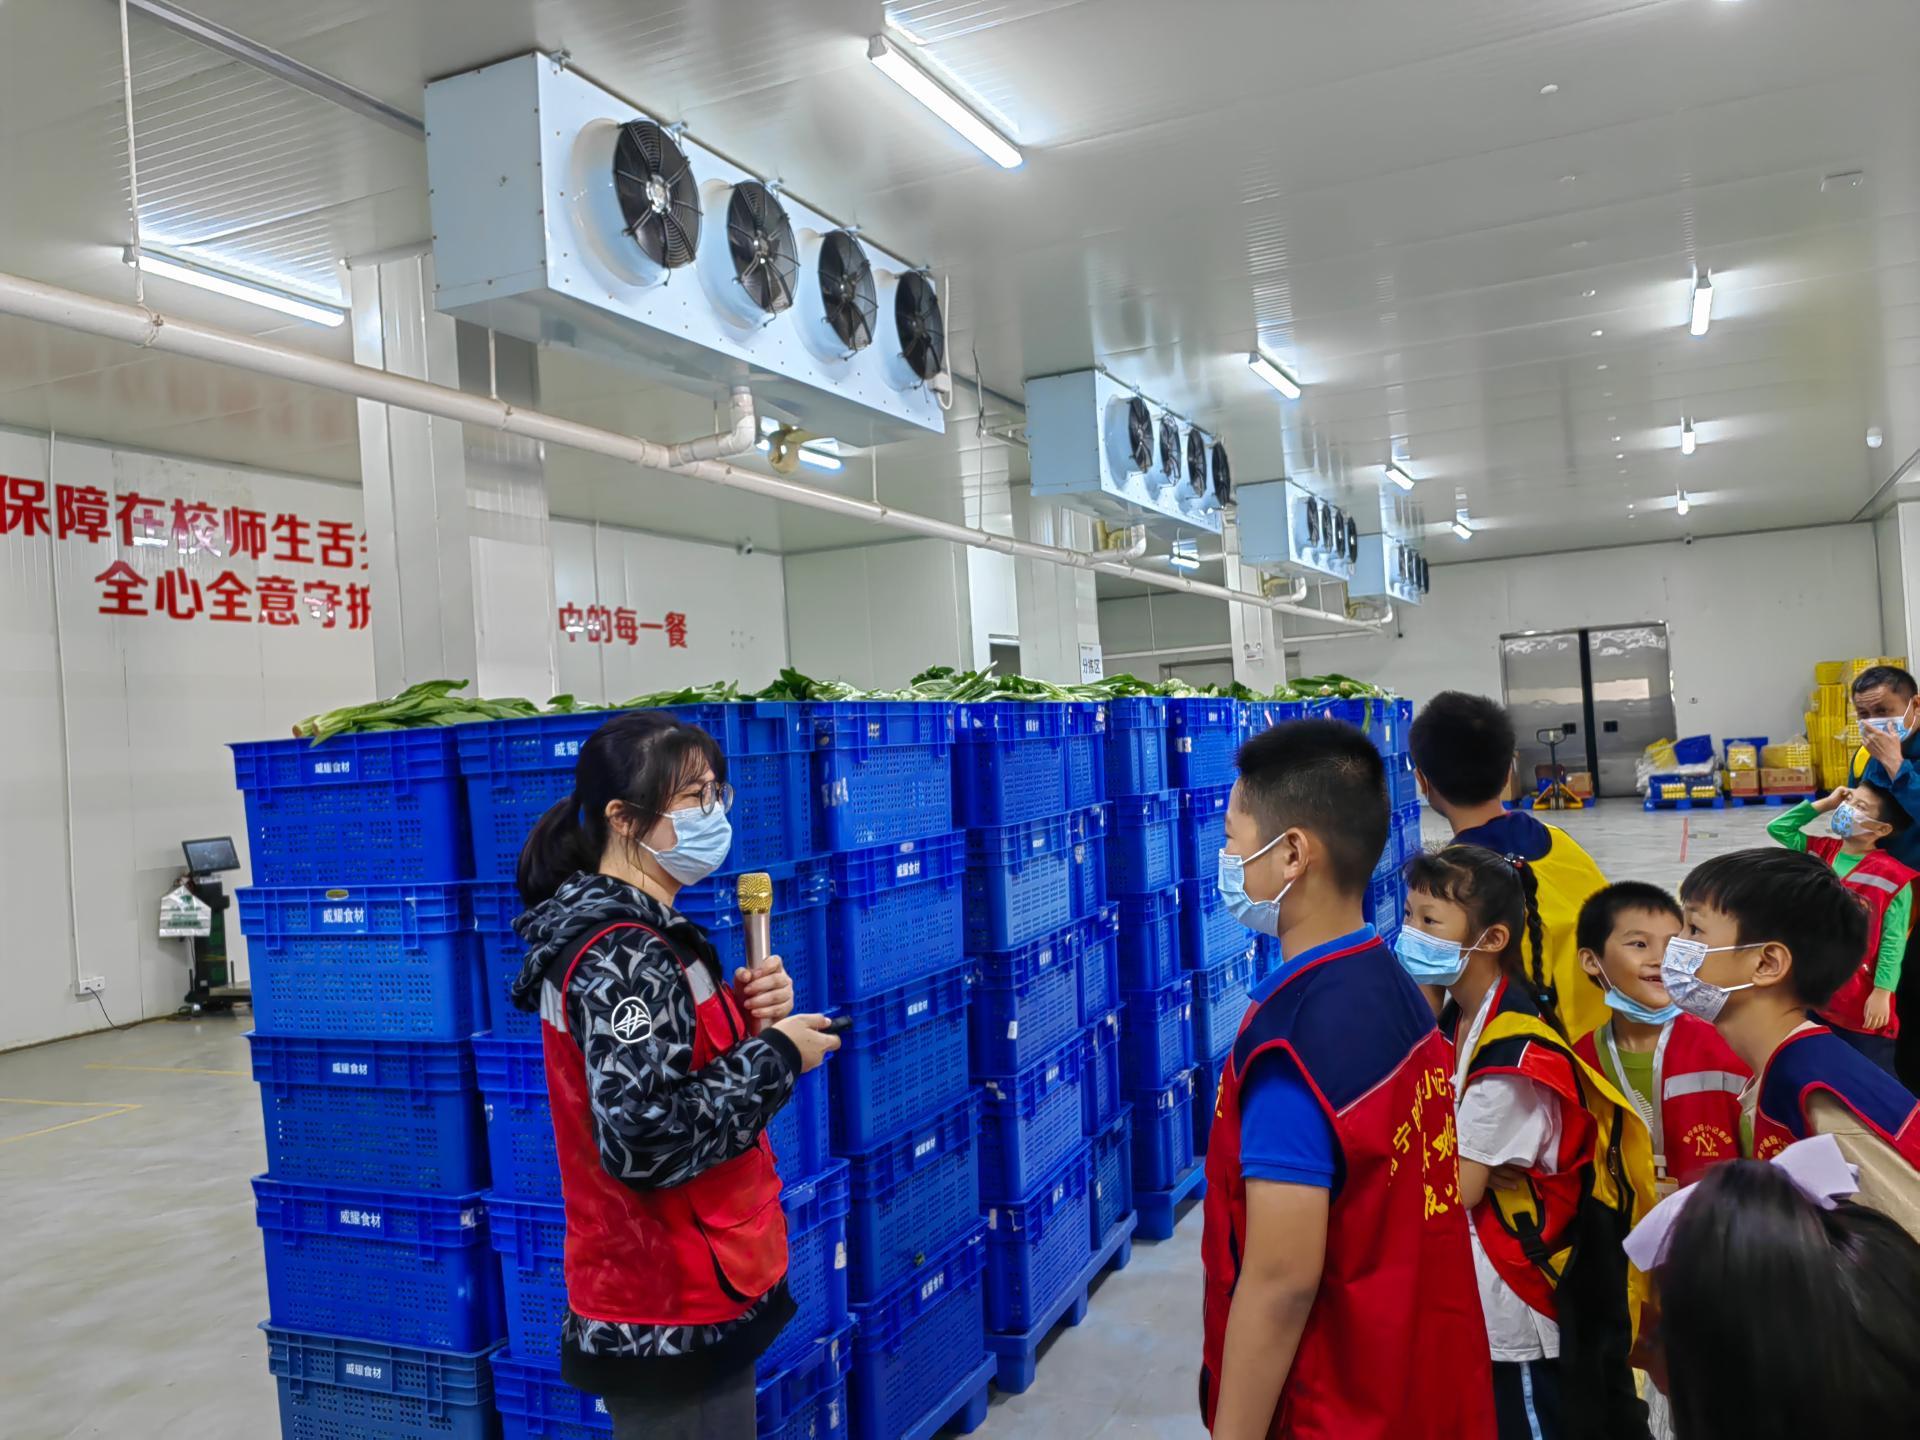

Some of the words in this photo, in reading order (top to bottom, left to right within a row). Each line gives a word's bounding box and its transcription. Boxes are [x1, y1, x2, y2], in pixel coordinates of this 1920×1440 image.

[0, 475, 370, 570] 保障在校师生舌
[558, 602, 688, 648] 中的每一餐
